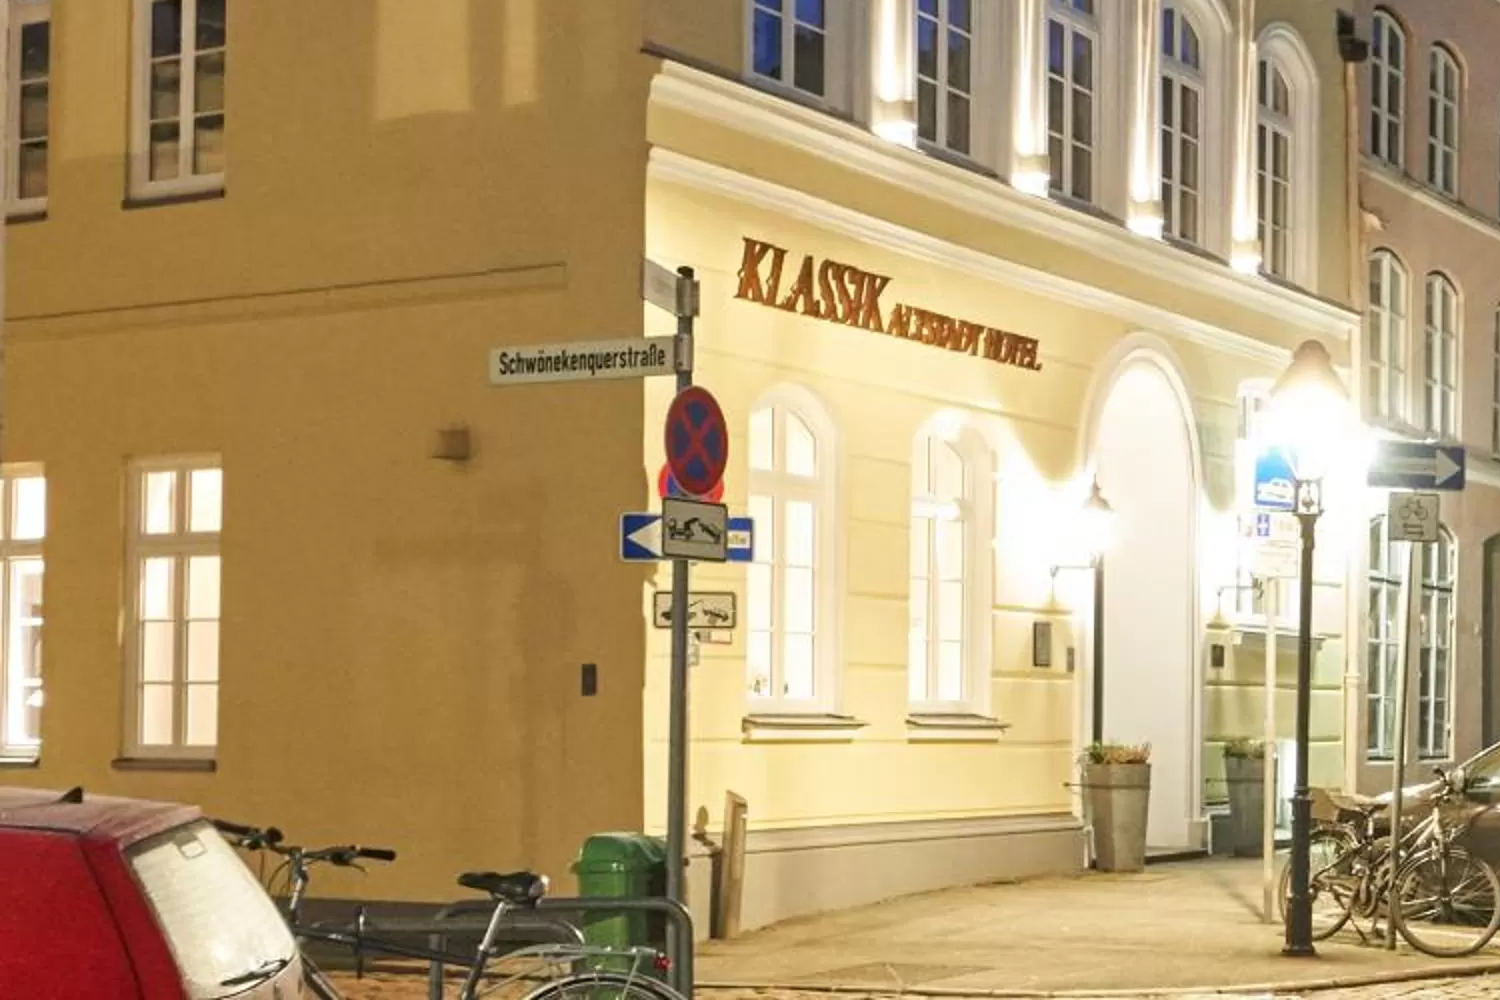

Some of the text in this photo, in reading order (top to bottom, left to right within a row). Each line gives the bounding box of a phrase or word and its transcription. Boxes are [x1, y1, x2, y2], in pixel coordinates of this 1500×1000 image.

[733, 237, 893, 334] KLASSIK
[982, 327, 1042, 371] HOTEL
[499, 344, 666, 376] Schwönekenquerstraße
